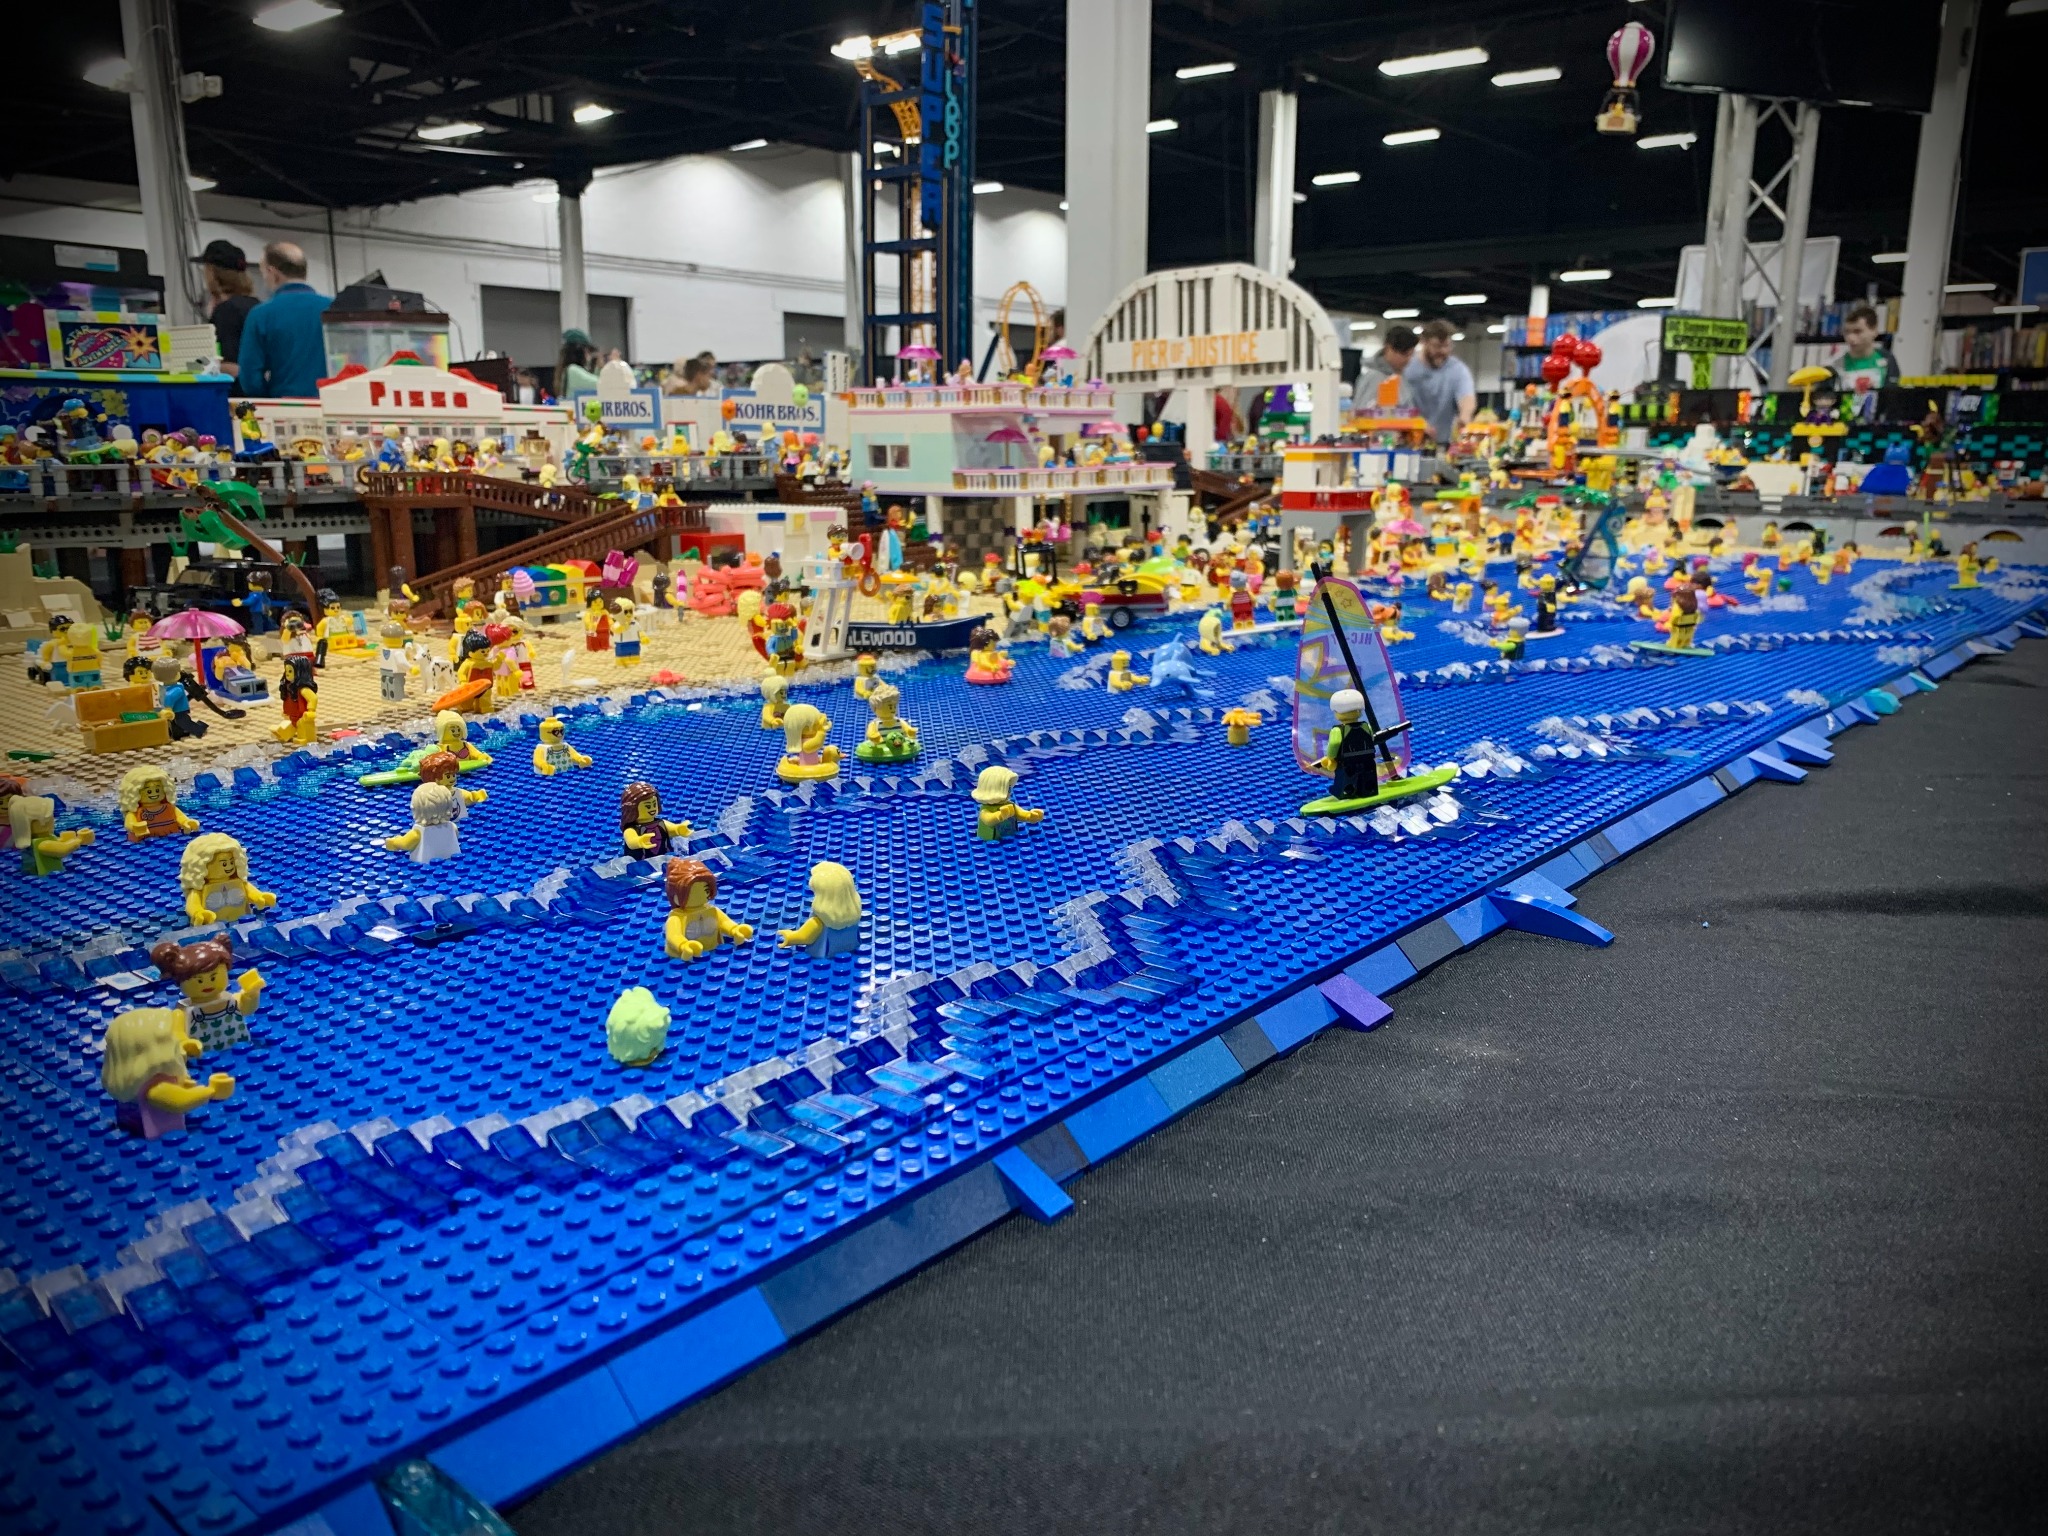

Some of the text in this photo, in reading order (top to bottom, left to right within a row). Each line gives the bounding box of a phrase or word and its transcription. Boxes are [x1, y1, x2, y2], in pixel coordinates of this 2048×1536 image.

[921, 3, 944, 225] SUPER
[1131, 339, 1169, 370] PIER
[1187, 331, 1259, 367] JUSTICE
[614, 402, 651, 417] BROS.
[735, 403, 820, 422] KOHR BROS.
[848, 630, 917, 647] LEWOOD
